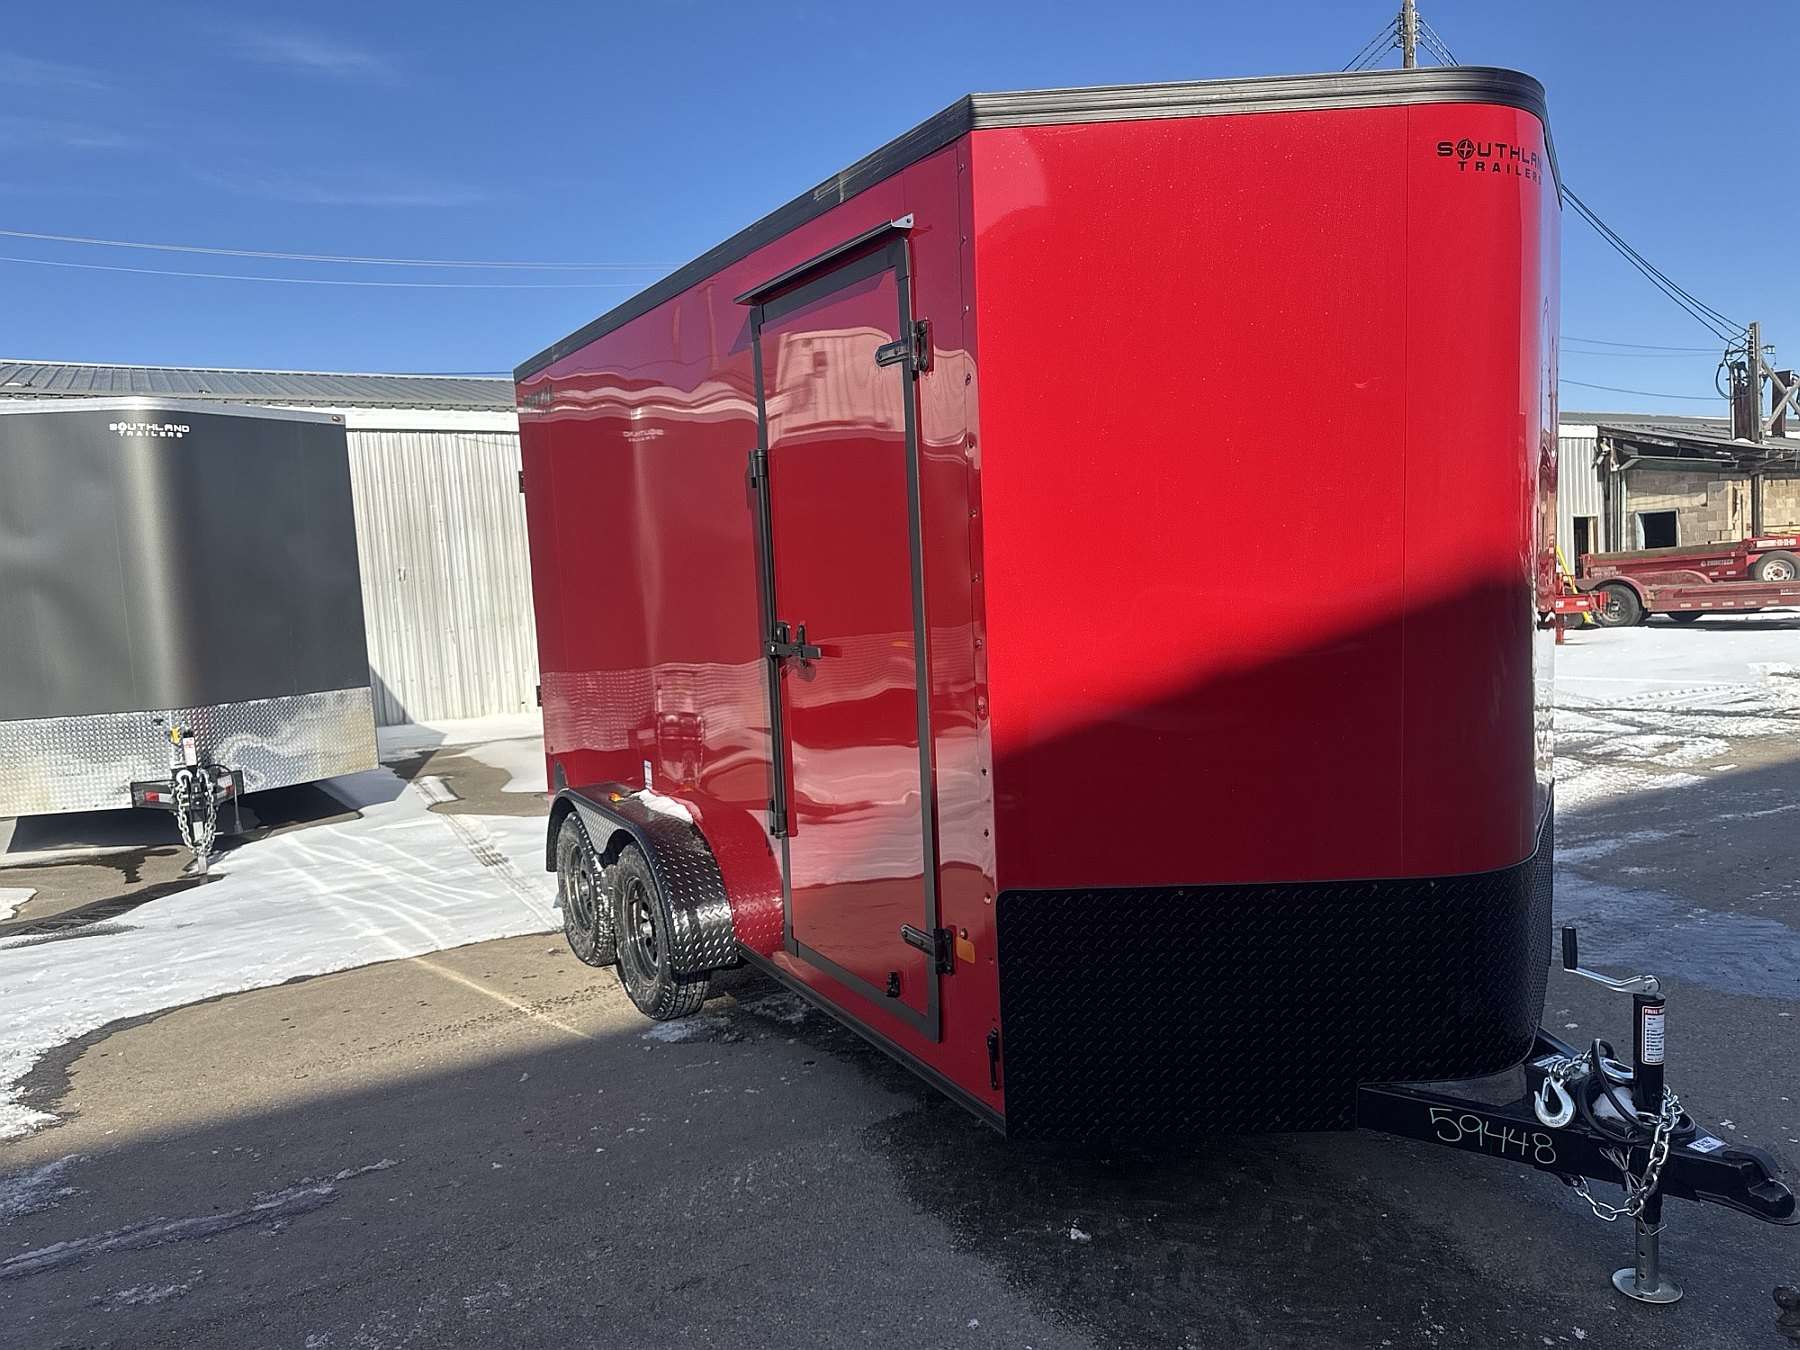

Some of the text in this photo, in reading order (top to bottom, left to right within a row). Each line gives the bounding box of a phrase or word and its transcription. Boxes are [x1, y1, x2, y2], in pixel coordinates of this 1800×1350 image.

[1437, 139, 1542, 169] SOUTHLA
[109, 421, 190, 433] SOUTHLAND
[118, 430, 183, 438] TRAILERS
[1429, 1107, 1557, 1164] 59448
